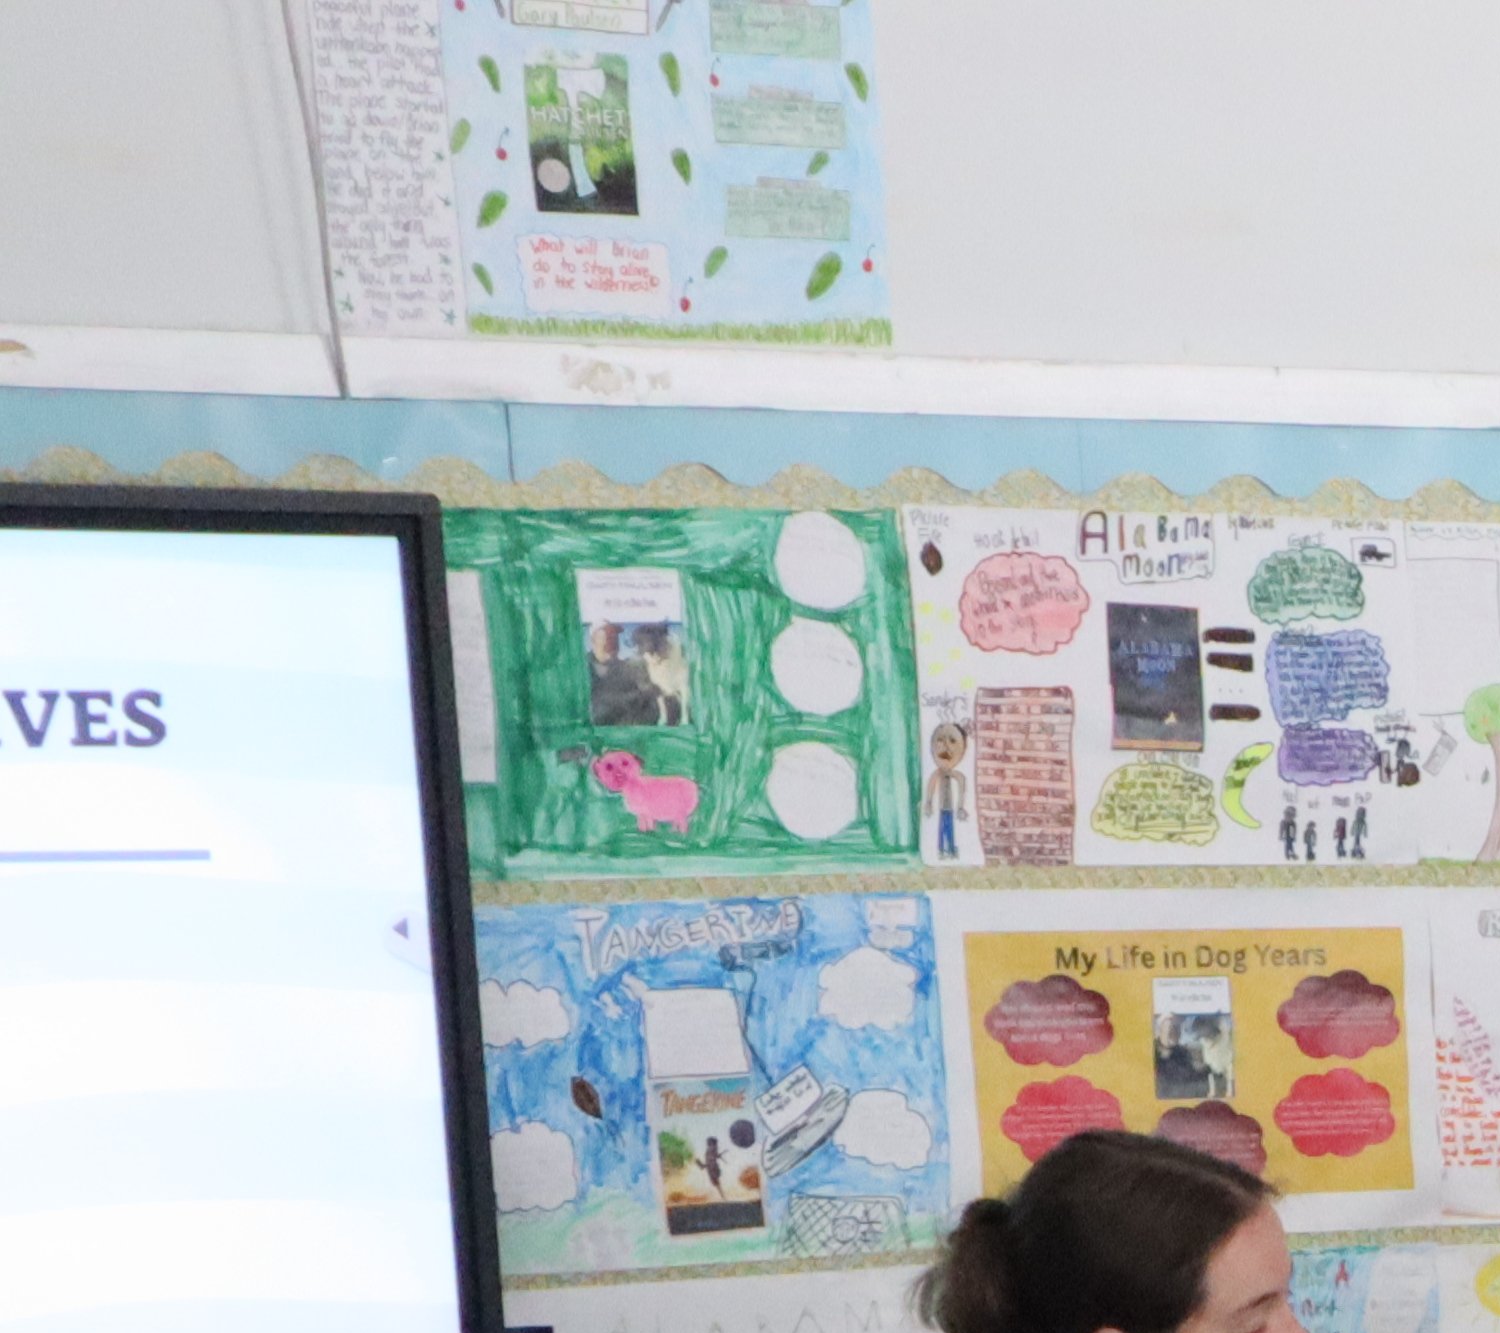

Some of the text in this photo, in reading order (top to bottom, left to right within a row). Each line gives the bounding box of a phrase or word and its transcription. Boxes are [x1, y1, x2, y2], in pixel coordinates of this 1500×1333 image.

[530, 106, 626, 126] HATCHET
[0, 687, 168, 749] VES
[1055, 944, 1326, 975] My Life in Dog Years
